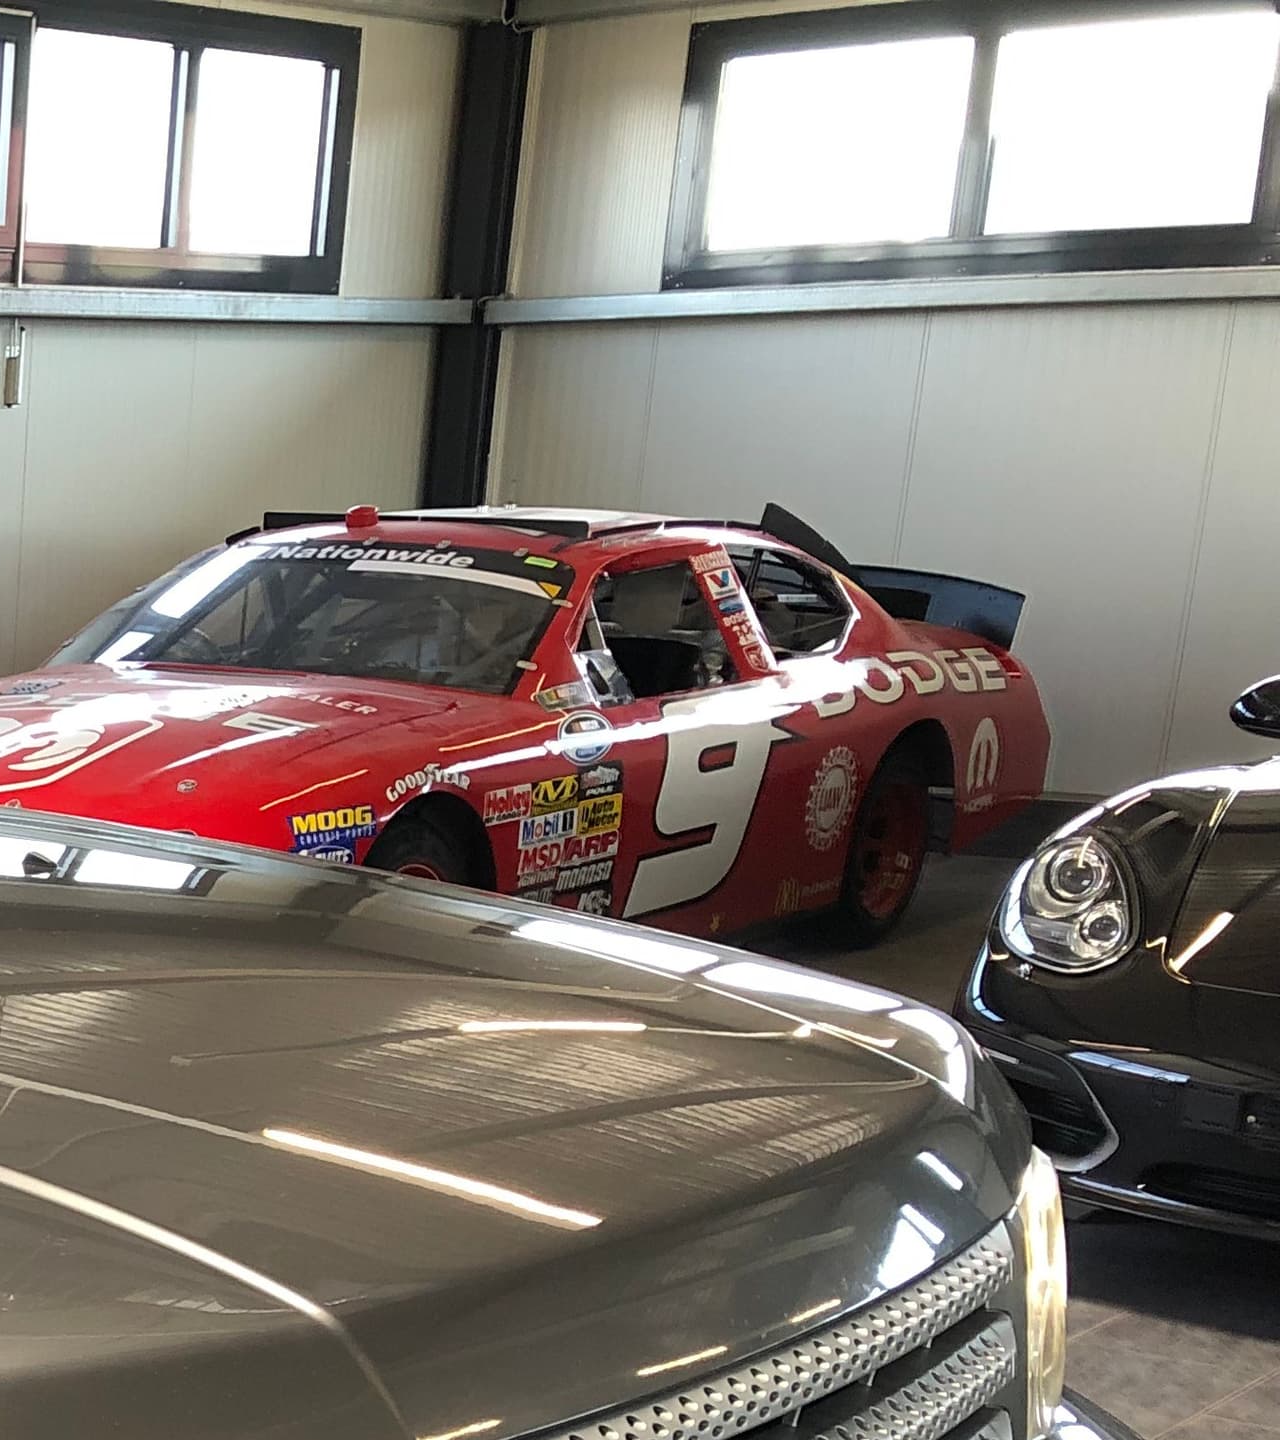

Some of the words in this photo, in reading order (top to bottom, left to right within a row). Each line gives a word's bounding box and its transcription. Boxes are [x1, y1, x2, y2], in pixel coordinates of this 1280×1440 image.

[269, 544, 475, 568] Nationwide
[386, 764, 471, 802] GOODYEAR
[292, 805, 373, 835] MOOG
[624, 696, 792, 918] 9
[522, 812, 559, 842] Mobil
[520, 842, 561, 873] MSD
[563, 831, 618, 861] ARP
